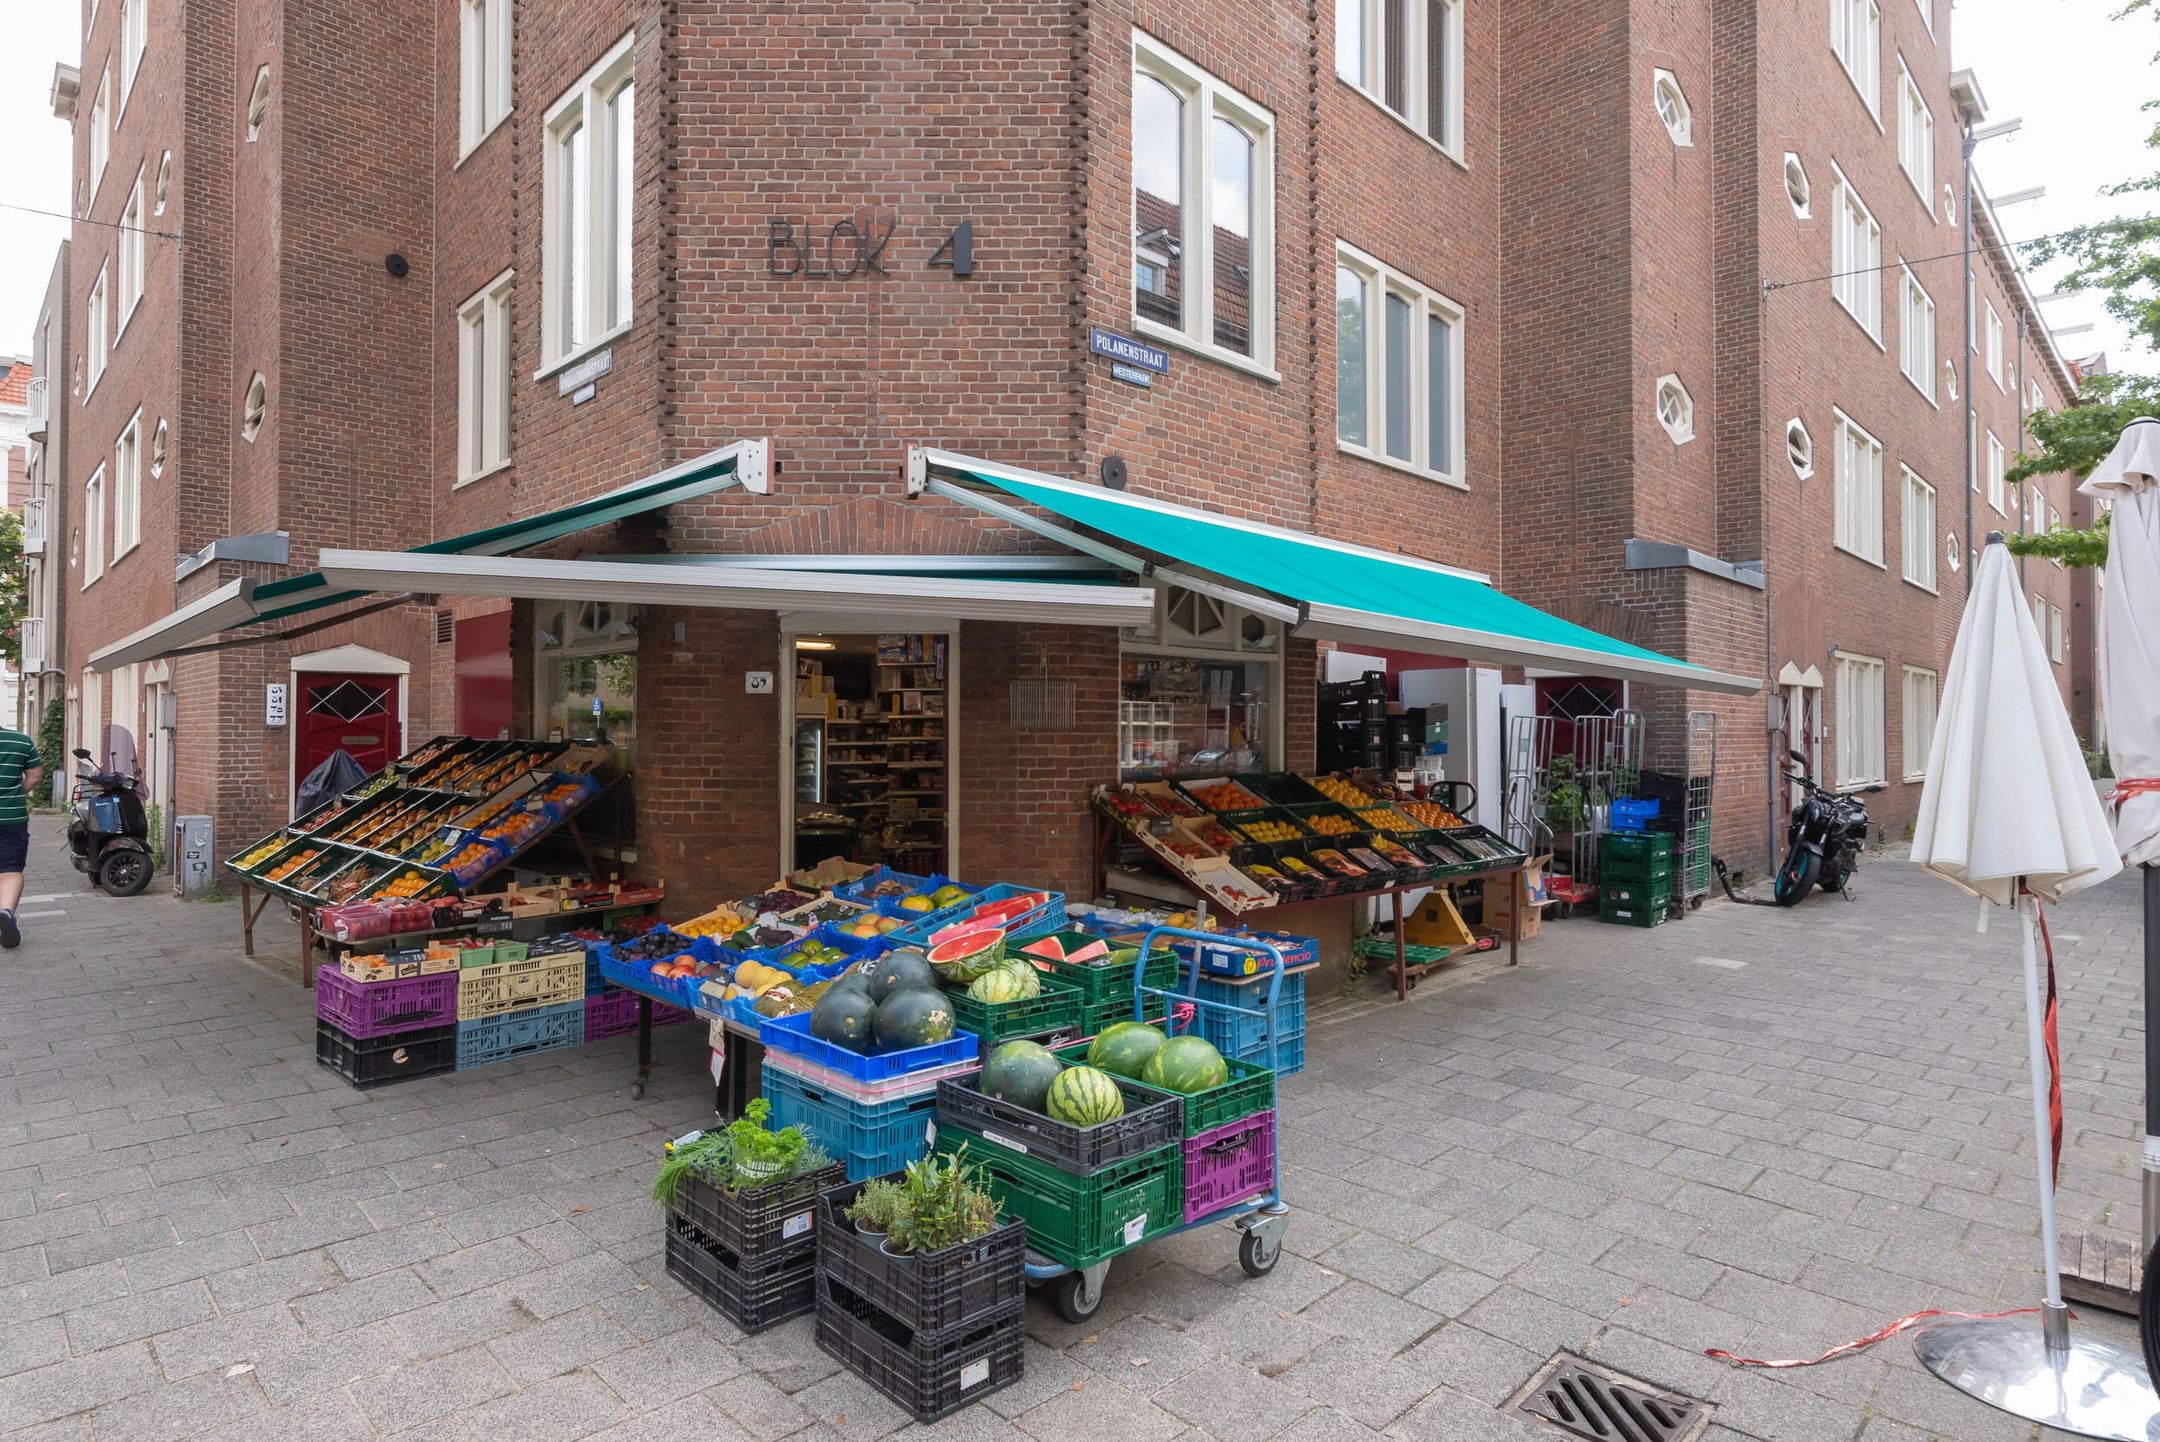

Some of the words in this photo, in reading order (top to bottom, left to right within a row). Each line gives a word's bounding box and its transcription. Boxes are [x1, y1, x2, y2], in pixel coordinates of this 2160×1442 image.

[770, 219, 896, 277] BLOK
[927, 220, 977, 276] 4
[1095, 334, 1164, 369] POLANENSTRAAT
[1112, 365, 1152, 384] WESTERPARK
